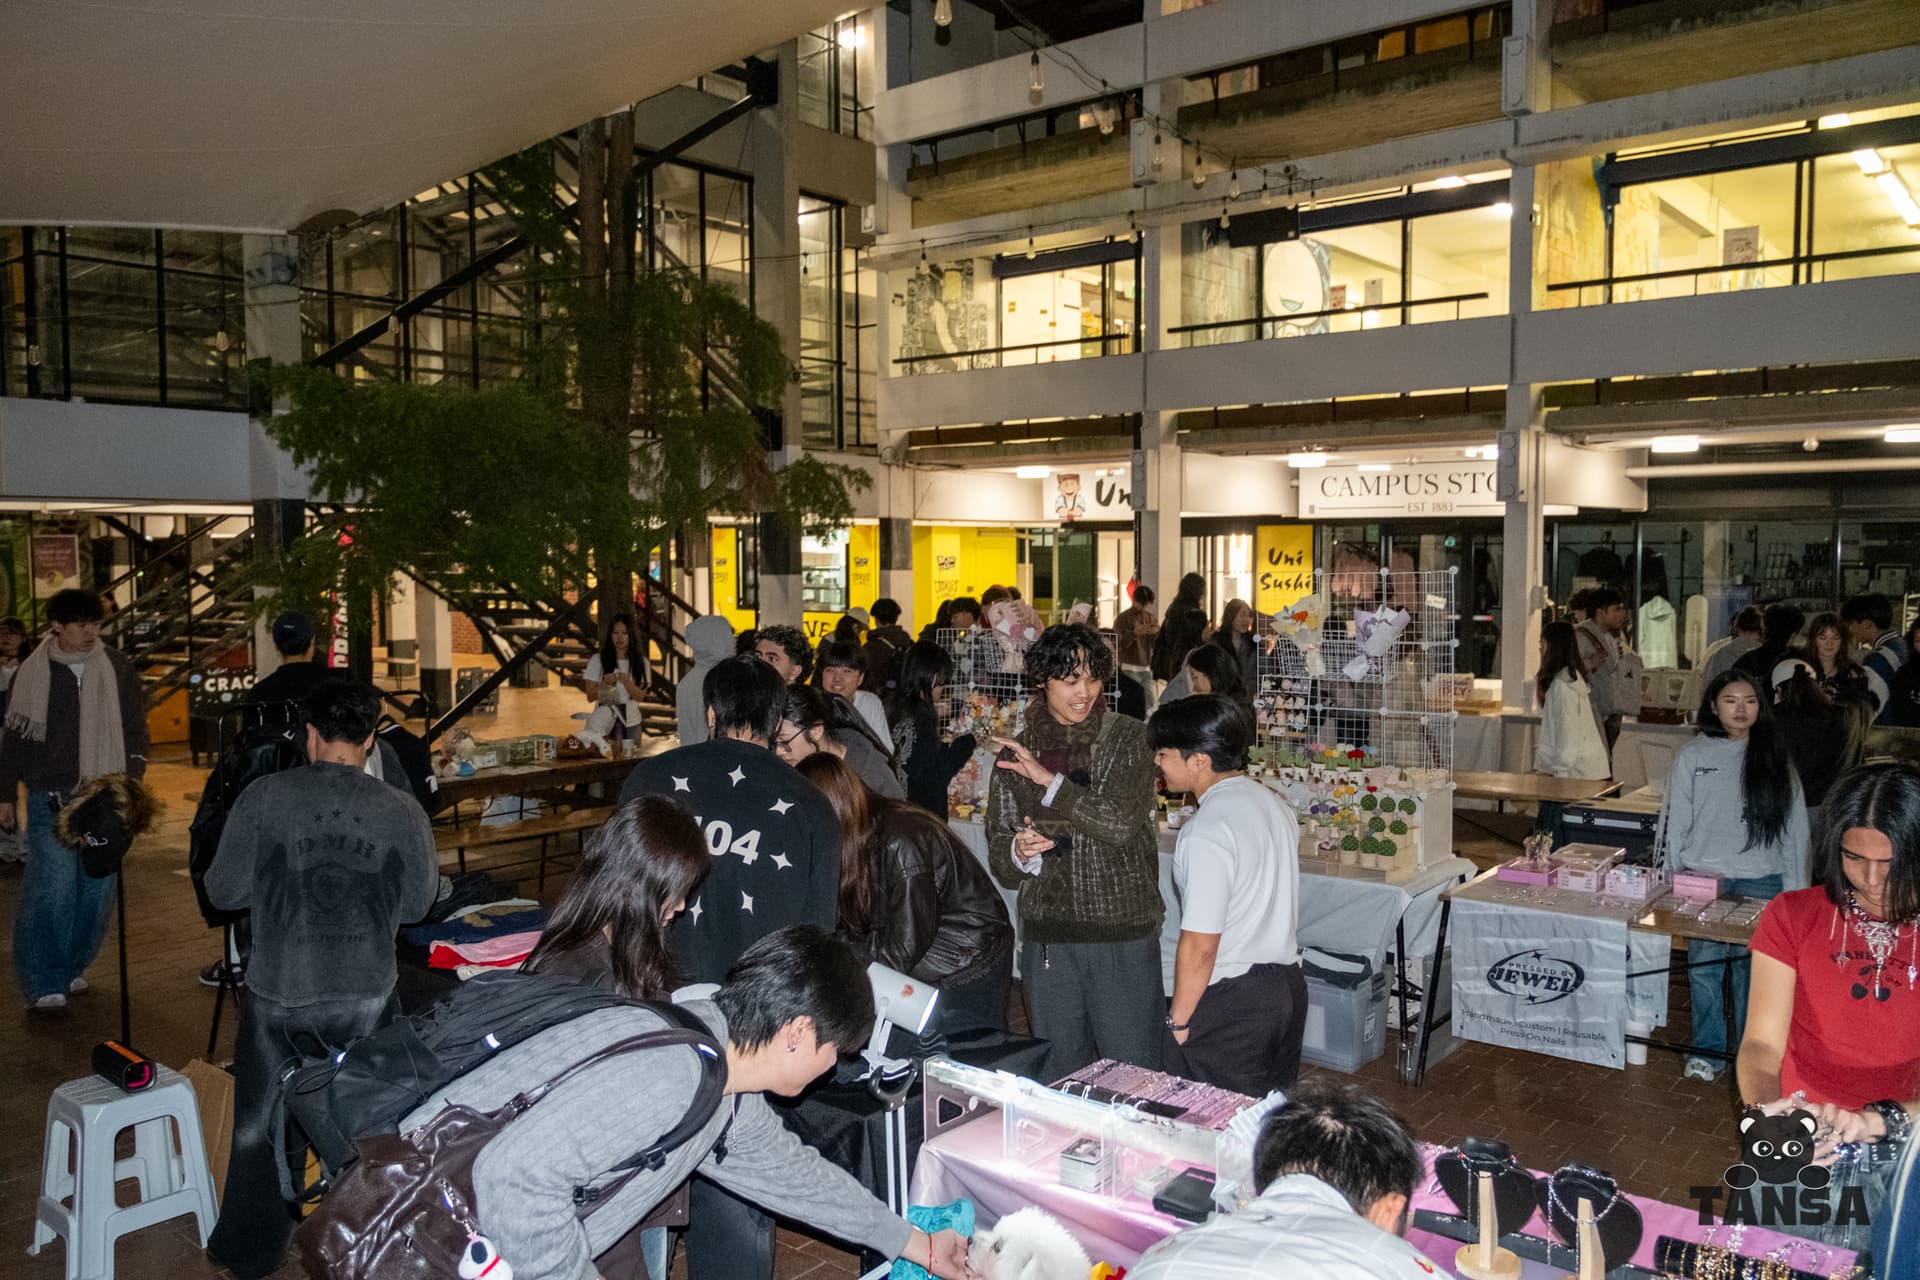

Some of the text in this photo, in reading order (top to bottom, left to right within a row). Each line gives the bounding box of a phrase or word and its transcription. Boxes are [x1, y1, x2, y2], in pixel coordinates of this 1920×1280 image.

[1320, 473, 1439, 498] CAMPUS
[1431, 501, 1454, 513] 1883
[1268, 546, 1304, 567] Uni
[1260, 572, 1312, 591] Sushi
[204, 675, 259, 692] CRAC
[694, 815, 762, 866] 04
[1489, 967, 1576, 993] JEWEL
[1508, 961, 1575, 979] PRESSED BY
[1519, 1020, 1556, 1033] Custom
[1562, 1027, 1607, 1042] Reusable
[1526, 1032, 1541, 1042] On
[1543, 1036, 1567, 1047] Nails
